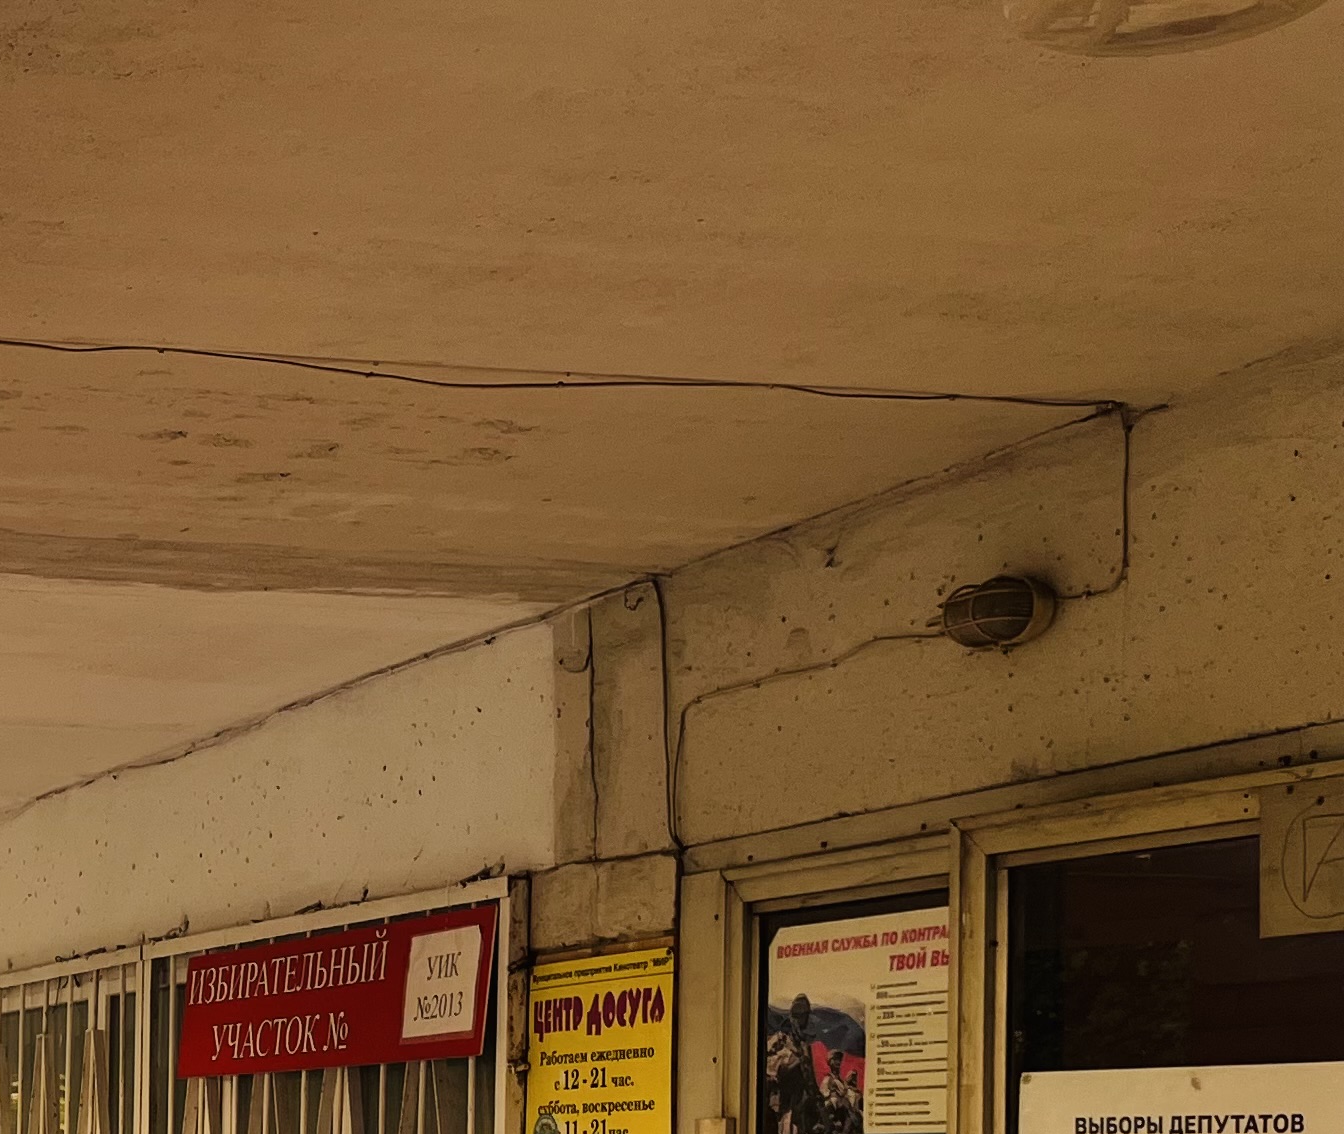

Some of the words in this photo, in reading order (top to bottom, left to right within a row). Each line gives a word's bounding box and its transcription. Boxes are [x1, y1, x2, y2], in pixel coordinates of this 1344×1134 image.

[777, 940, 829, 959] ВОЕННАЯ
[832, 934, 878, 952] СЛУЖБА
[881, 931, 898, 946] ПО
[901, 925, 949, 943] КОНТРА
[188, 929, 390, 1006] ИЗБИРАТЕЛЬНЫЙ
[426, 951, 462, 981] УИК
[889, 946, 928, 972] ТВОЙ
[413, 991, 464, 1022] №2013
[533, 996, 584, 1042] ЦЕНТР
[586, 984, 665, 1035] ДОСУГА
[212, 1013, 321, 1061] УЧАСТОК
[322, 1011, 349, 1052] №
[539, 1050, 588, 1066] Работаем
[590, 1047, 655, 1062] ежедневно
[563, 1068, 579, 1090] 12
[590, 1067, 607, 1088] 21
[611, 1075, 635, 1087] час.
[582, 1099, 655, 1116] воскресенье
[1074, 1116, 1163, 1134] ВЫБОРЫ
